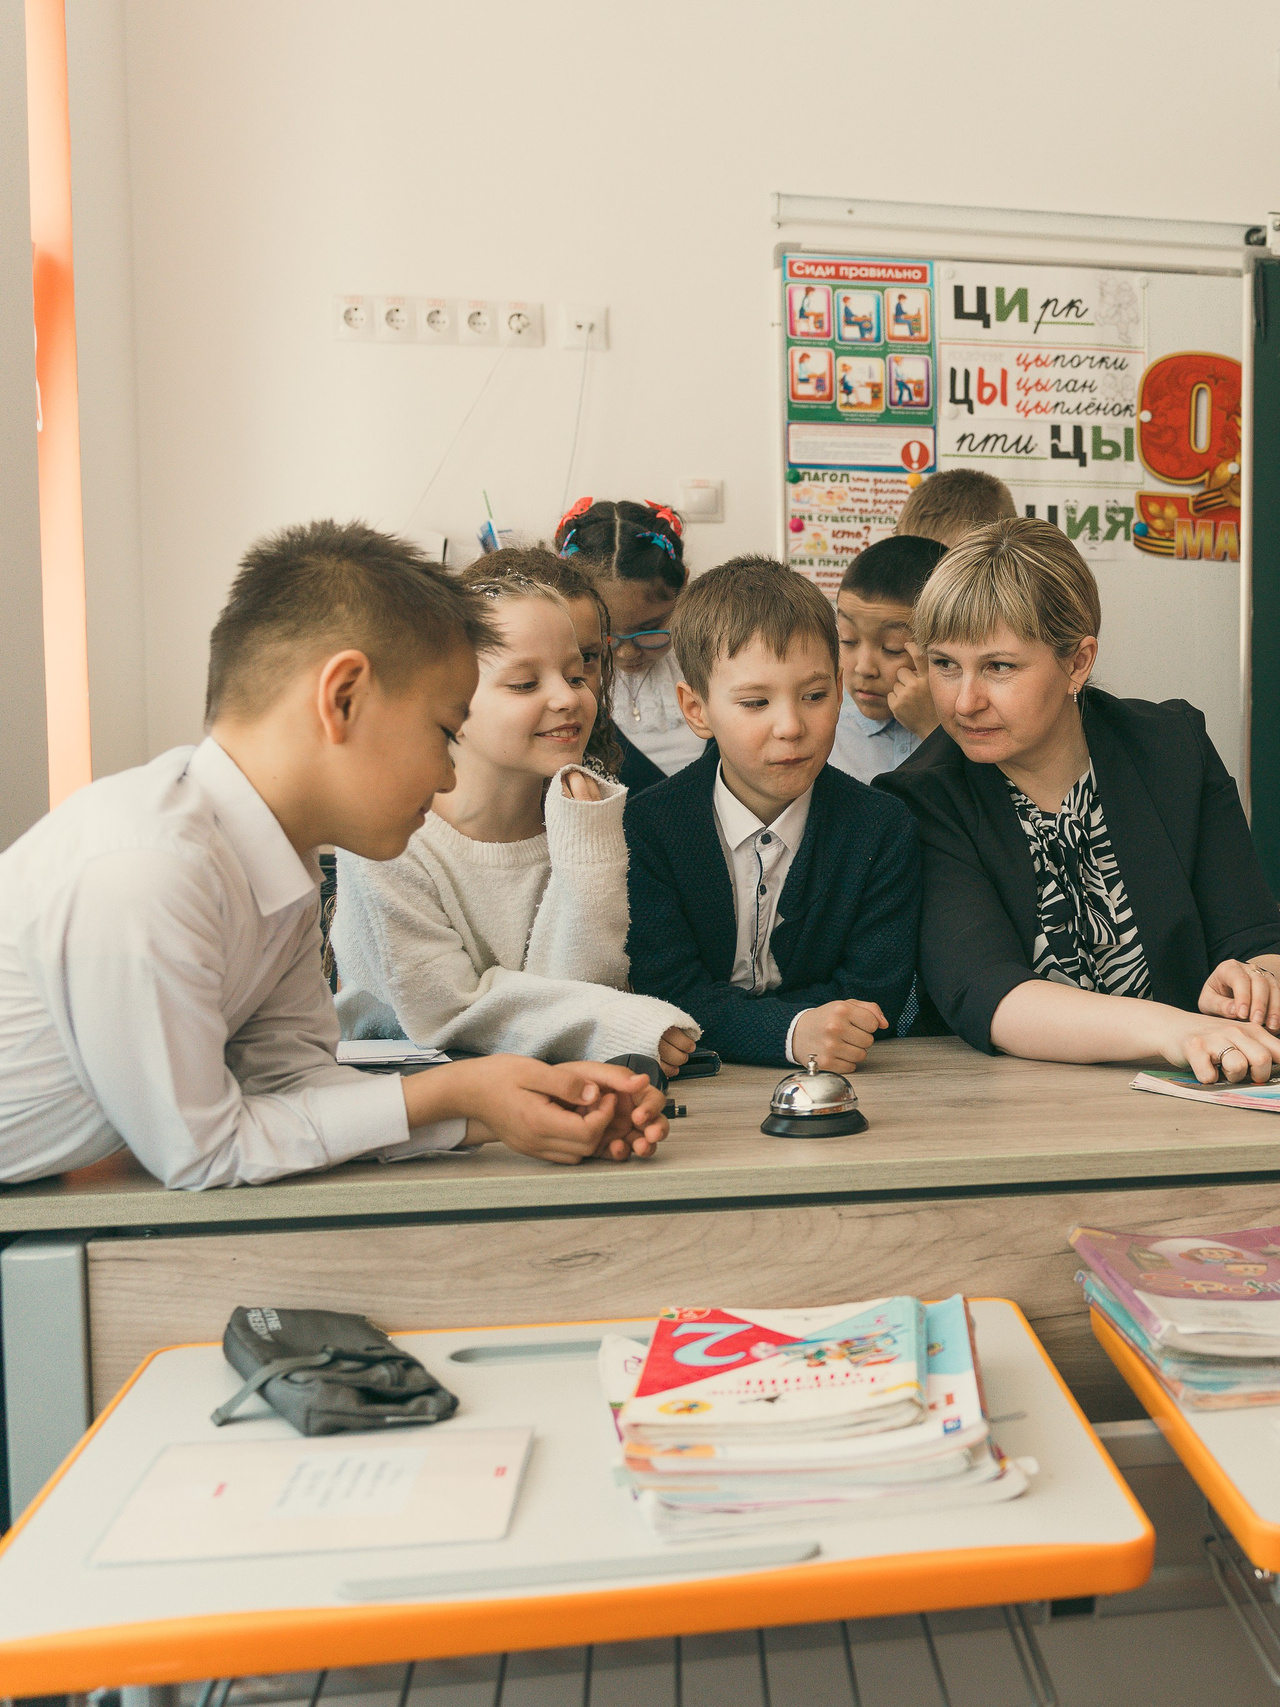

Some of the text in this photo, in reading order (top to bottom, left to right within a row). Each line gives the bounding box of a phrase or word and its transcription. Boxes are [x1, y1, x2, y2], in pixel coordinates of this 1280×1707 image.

[792, 261, 922, 280] Сиди правильно
[1016, 352, 1129, 372] цыпочки
[949, 366, 1008, 414] ЦЫ
[1016, 376, 1097, 396] цыган
[1015, 397, 1136, 418] цыплёнок
[800, 471, 850, 483] ЛАГОЛ
[818, 514, 897, 525] СУЩЕСТВИТЕЛЬ
[1174, 518, 1242, 563] МА
[819, 558, 849, 567] ПРИЛ
[671, 1322, 754, 1367] 2
